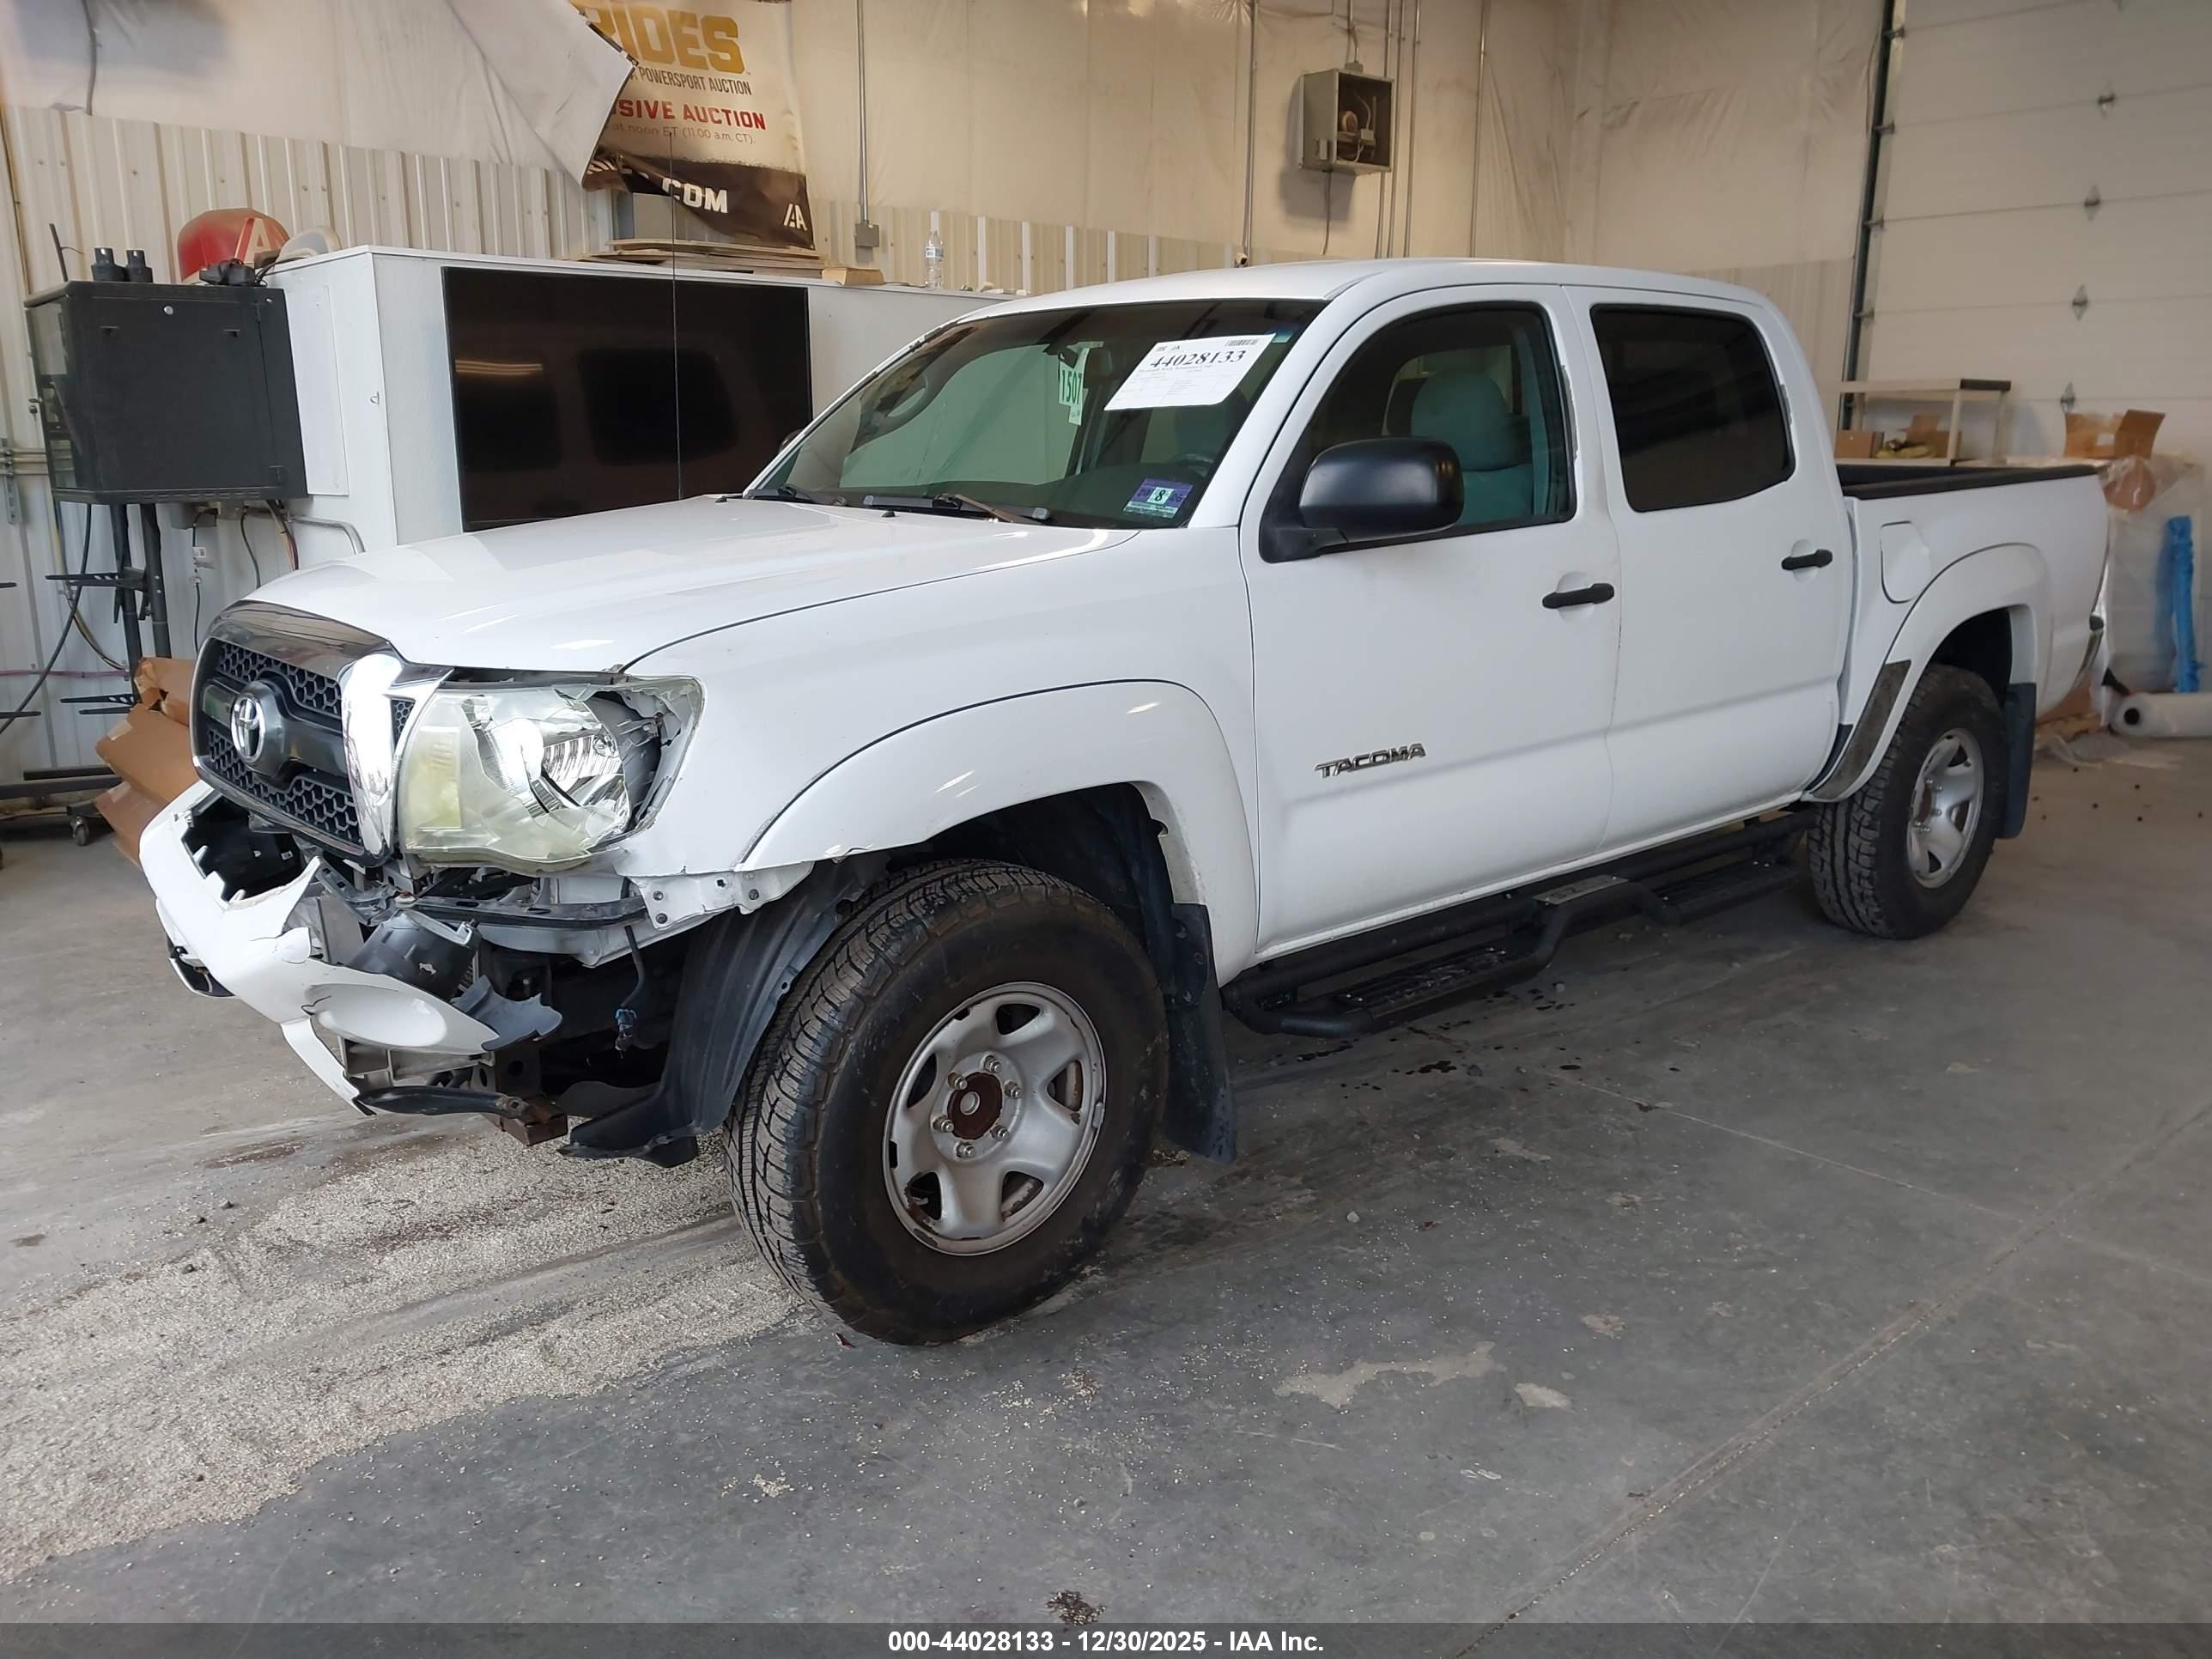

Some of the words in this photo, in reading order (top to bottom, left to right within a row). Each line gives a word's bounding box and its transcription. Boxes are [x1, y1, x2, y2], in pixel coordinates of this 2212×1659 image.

[638, 66, 707, 91] POWERSPORT
[709, 77, 752, 96] AUCTION
[611, 99, 676, 120] SIVE
[683, 103, 767, 131] AUCTION
[1150, 349, 1246, 368] 44028133
[1061, 369, 1082, 405] 1507
[1155, 489, 1166, 501] 8
[1315, 743, 1426, 778] TACOMA
